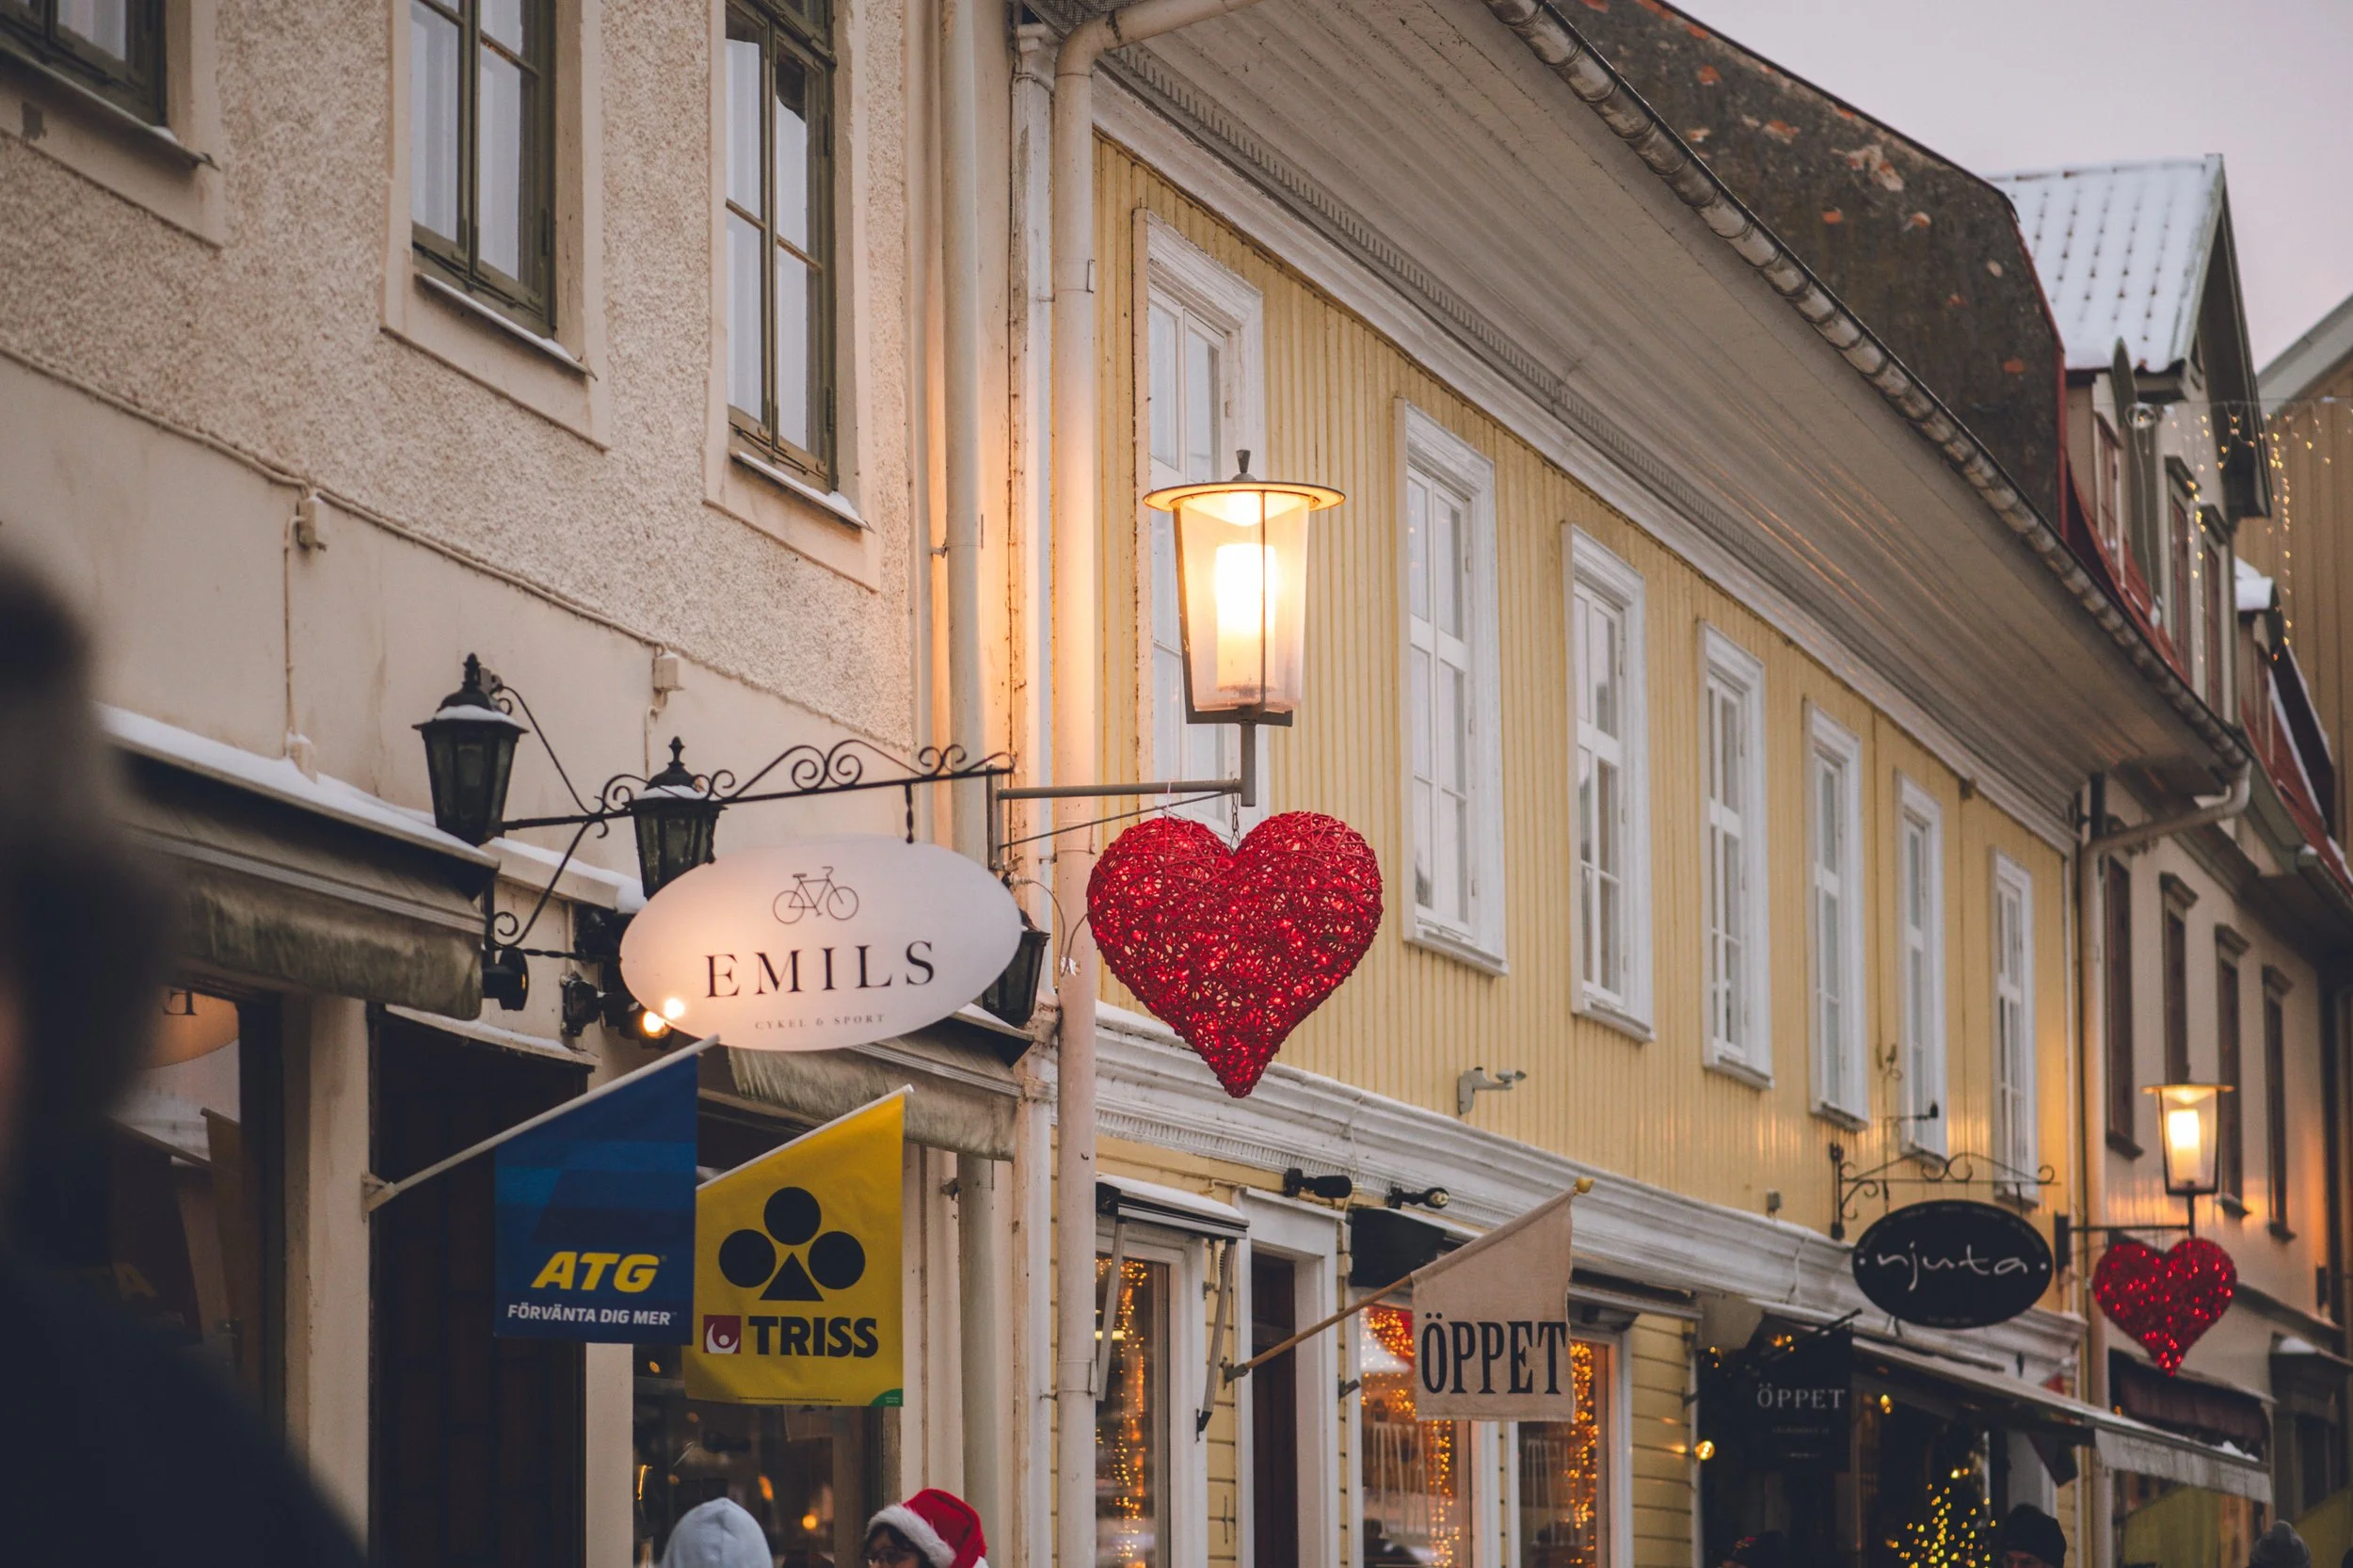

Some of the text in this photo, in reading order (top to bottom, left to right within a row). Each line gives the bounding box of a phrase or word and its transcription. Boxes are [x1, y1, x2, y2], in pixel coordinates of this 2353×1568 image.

[704, 940, 936, 999] EMILS
[754, 1018, 807, 1031] CYKEL
[833, 1013, 885, 1026] SPORT
[530, 1250, 659, 1293] ATG
[1877, 1240, 2028, 1291] njuta
[507, 1302, 597, 1322] FÖRVÄNTA
[600, 1309, 630, 1324] DIG
[748, 1316, 879, 1358] TRISS
[1421, 1312, 1567, 1395] ÖPPET
[1756, 1382, 1846, 1409] ÖPPET
